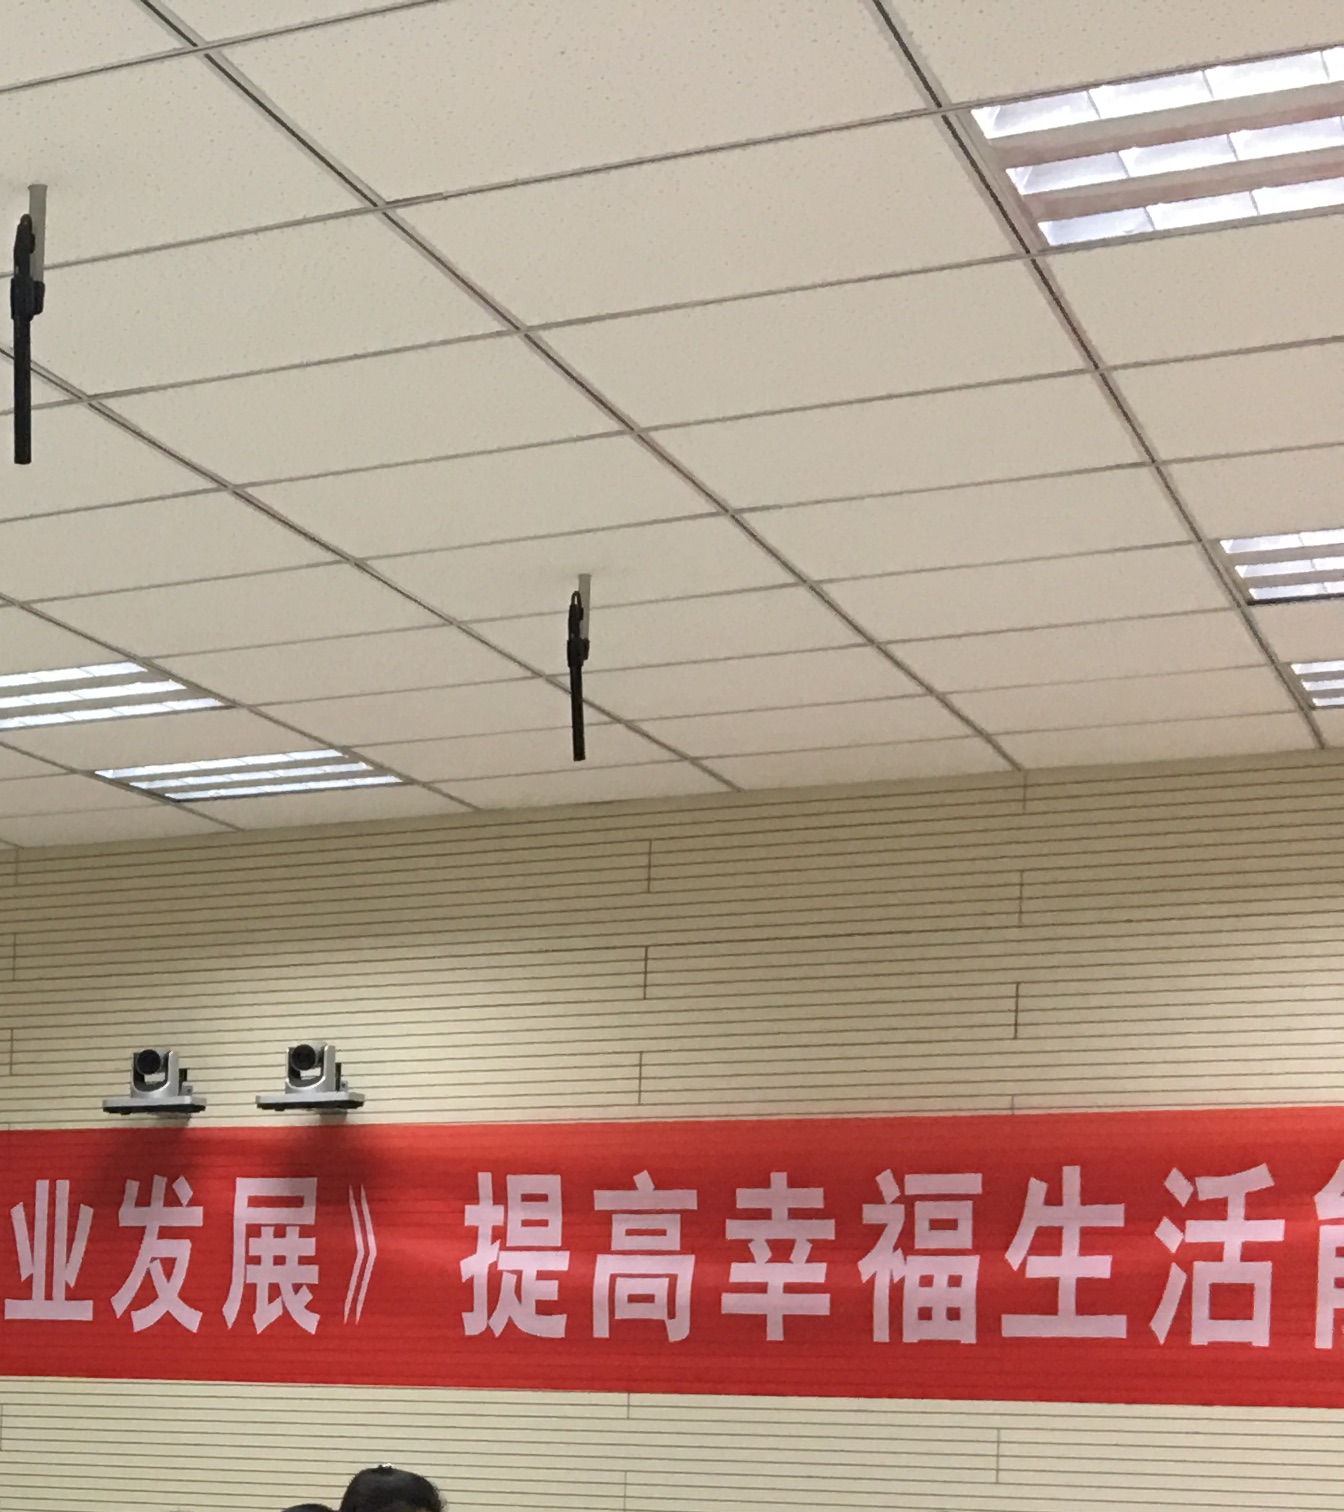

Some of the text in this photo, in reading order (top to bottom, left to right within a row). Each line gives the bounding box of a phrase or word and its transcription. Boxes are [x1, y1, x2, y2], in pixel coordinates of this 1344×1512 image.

[460, 1159, 1343, 1349] 提高幸福生活
